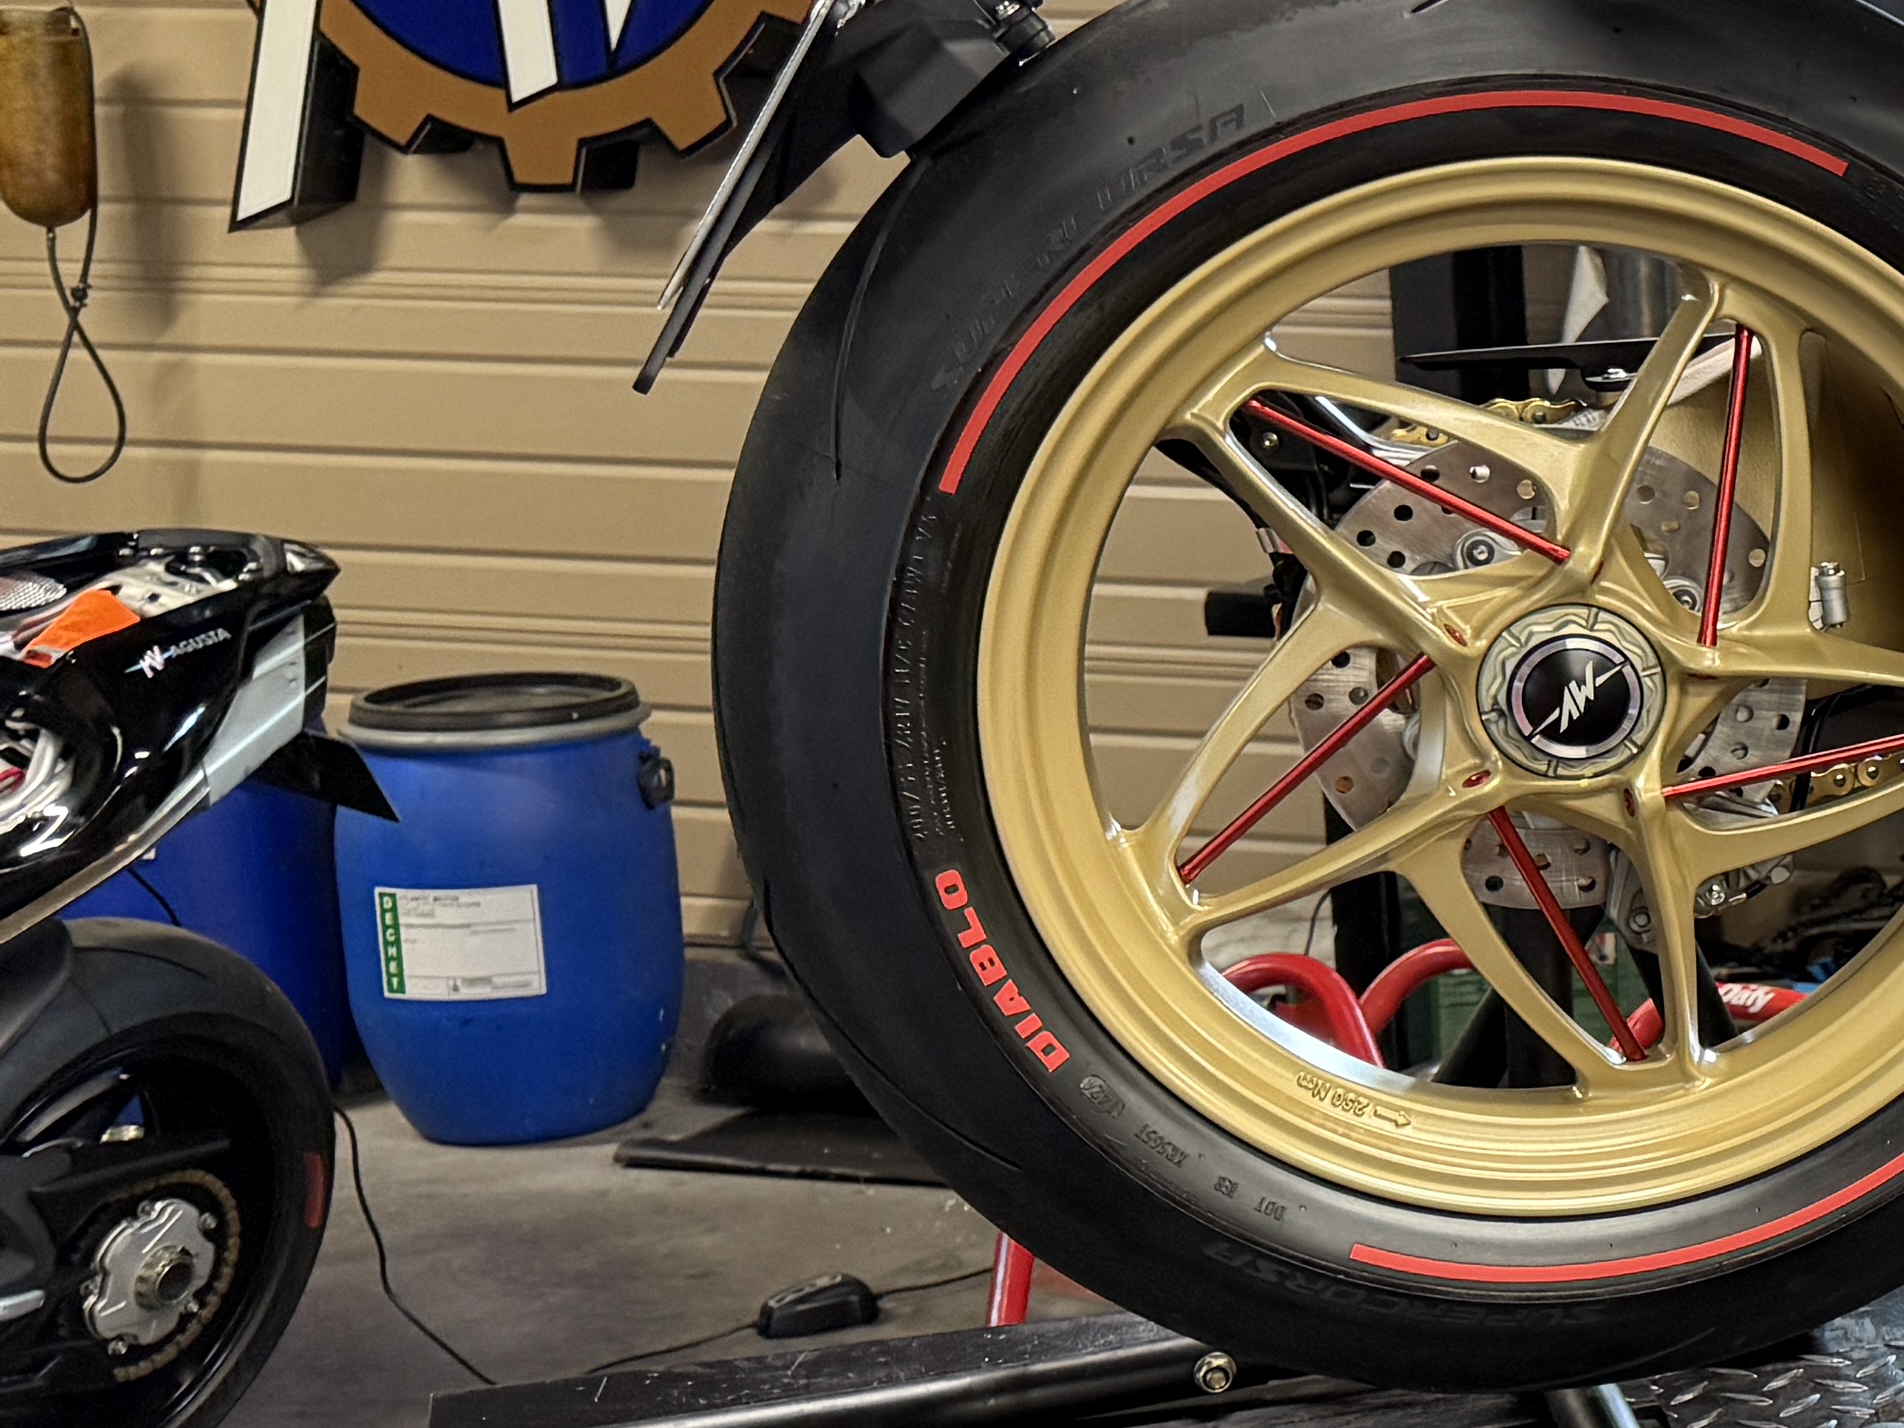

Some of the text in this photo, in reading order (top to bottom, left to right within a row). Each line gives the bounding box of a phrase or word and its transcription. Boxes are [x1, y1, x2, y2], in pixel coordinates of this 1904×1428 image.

[138, 627, 232, 679] MV AGUSTA
[934, 868, 1071, 1073] DIABLO
[1296, 1071, 1370, 1117] 250 Nm
